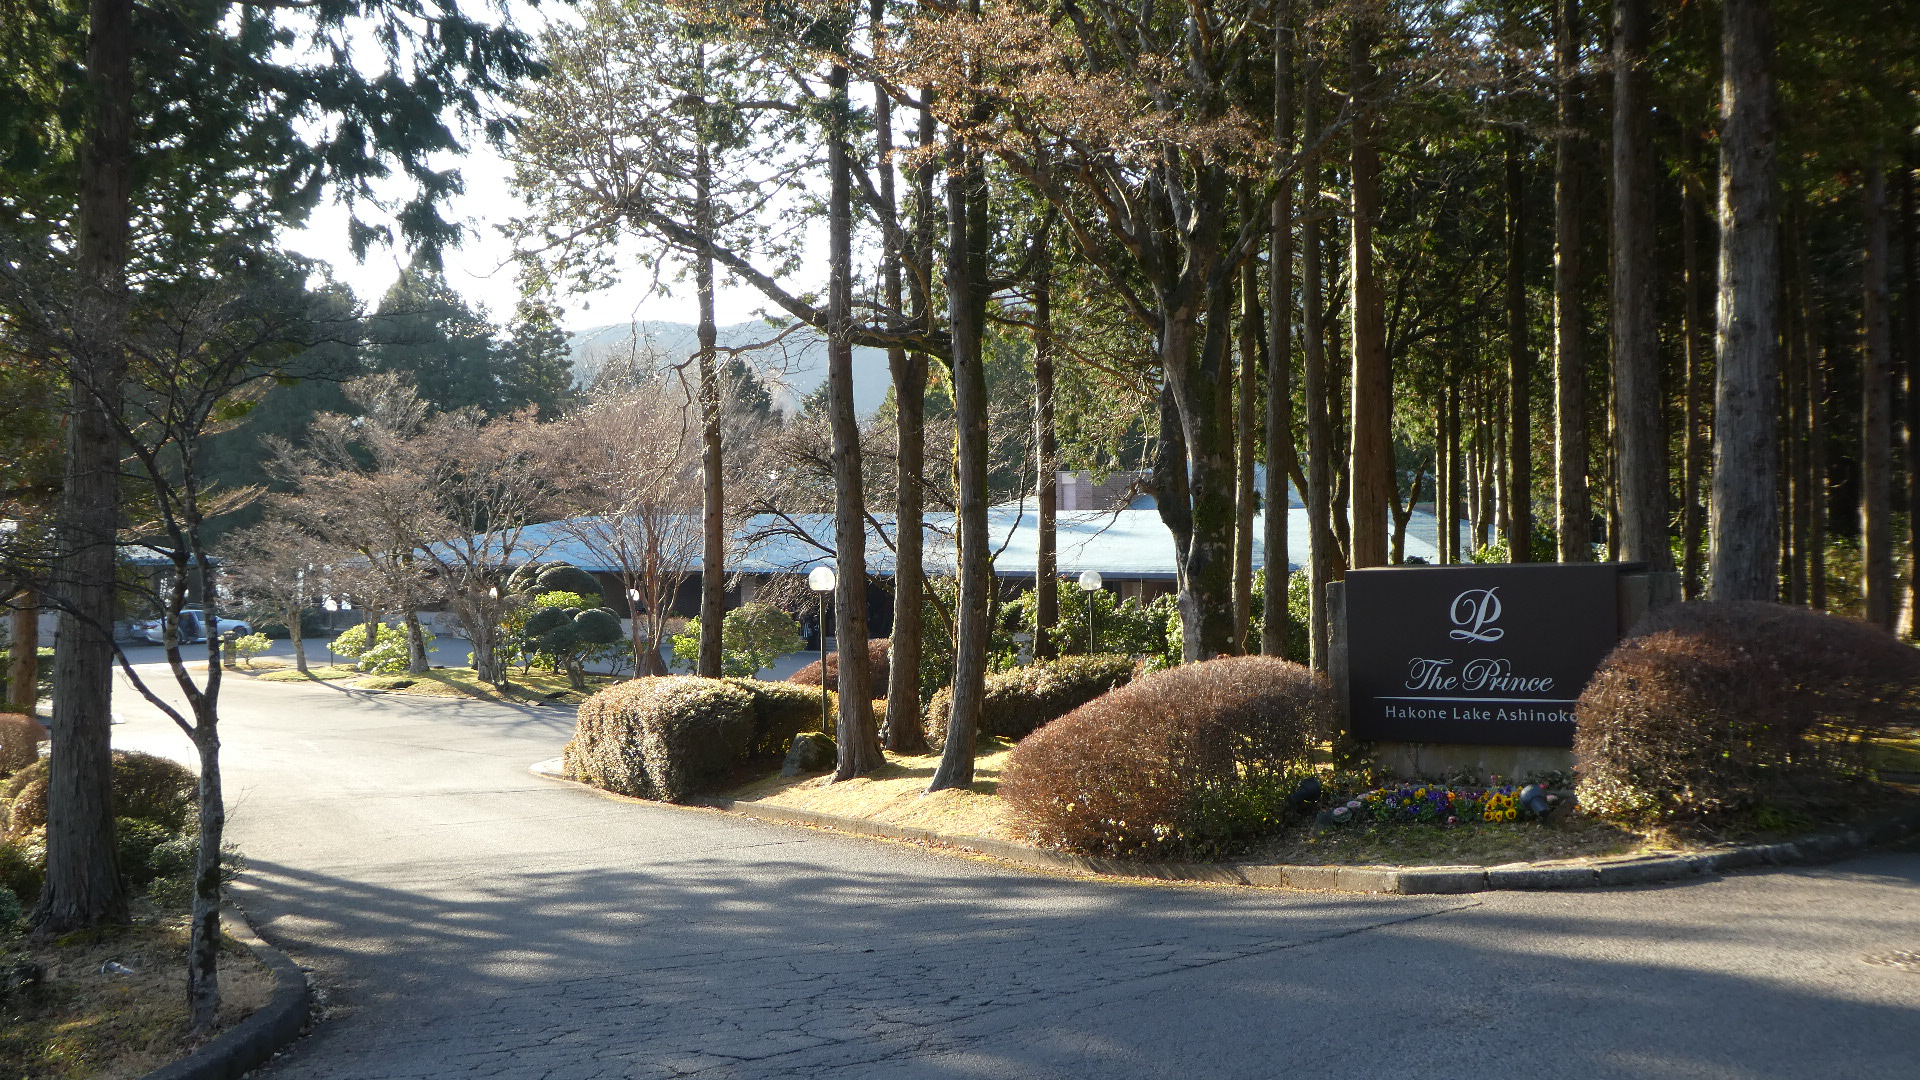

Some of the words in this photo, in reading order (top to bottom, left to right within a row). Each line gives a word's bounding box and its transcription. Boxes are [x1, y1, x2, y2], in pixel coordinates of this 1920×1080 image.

[1405, 657, 1458, 690] The
[1462, 658, 1554, 692] Prince
[1385, 705, 1447, 719] Hakone
[1453, 707, 1491, 720] Lake
[1496, 708, 1579, 722] Ashinoko
